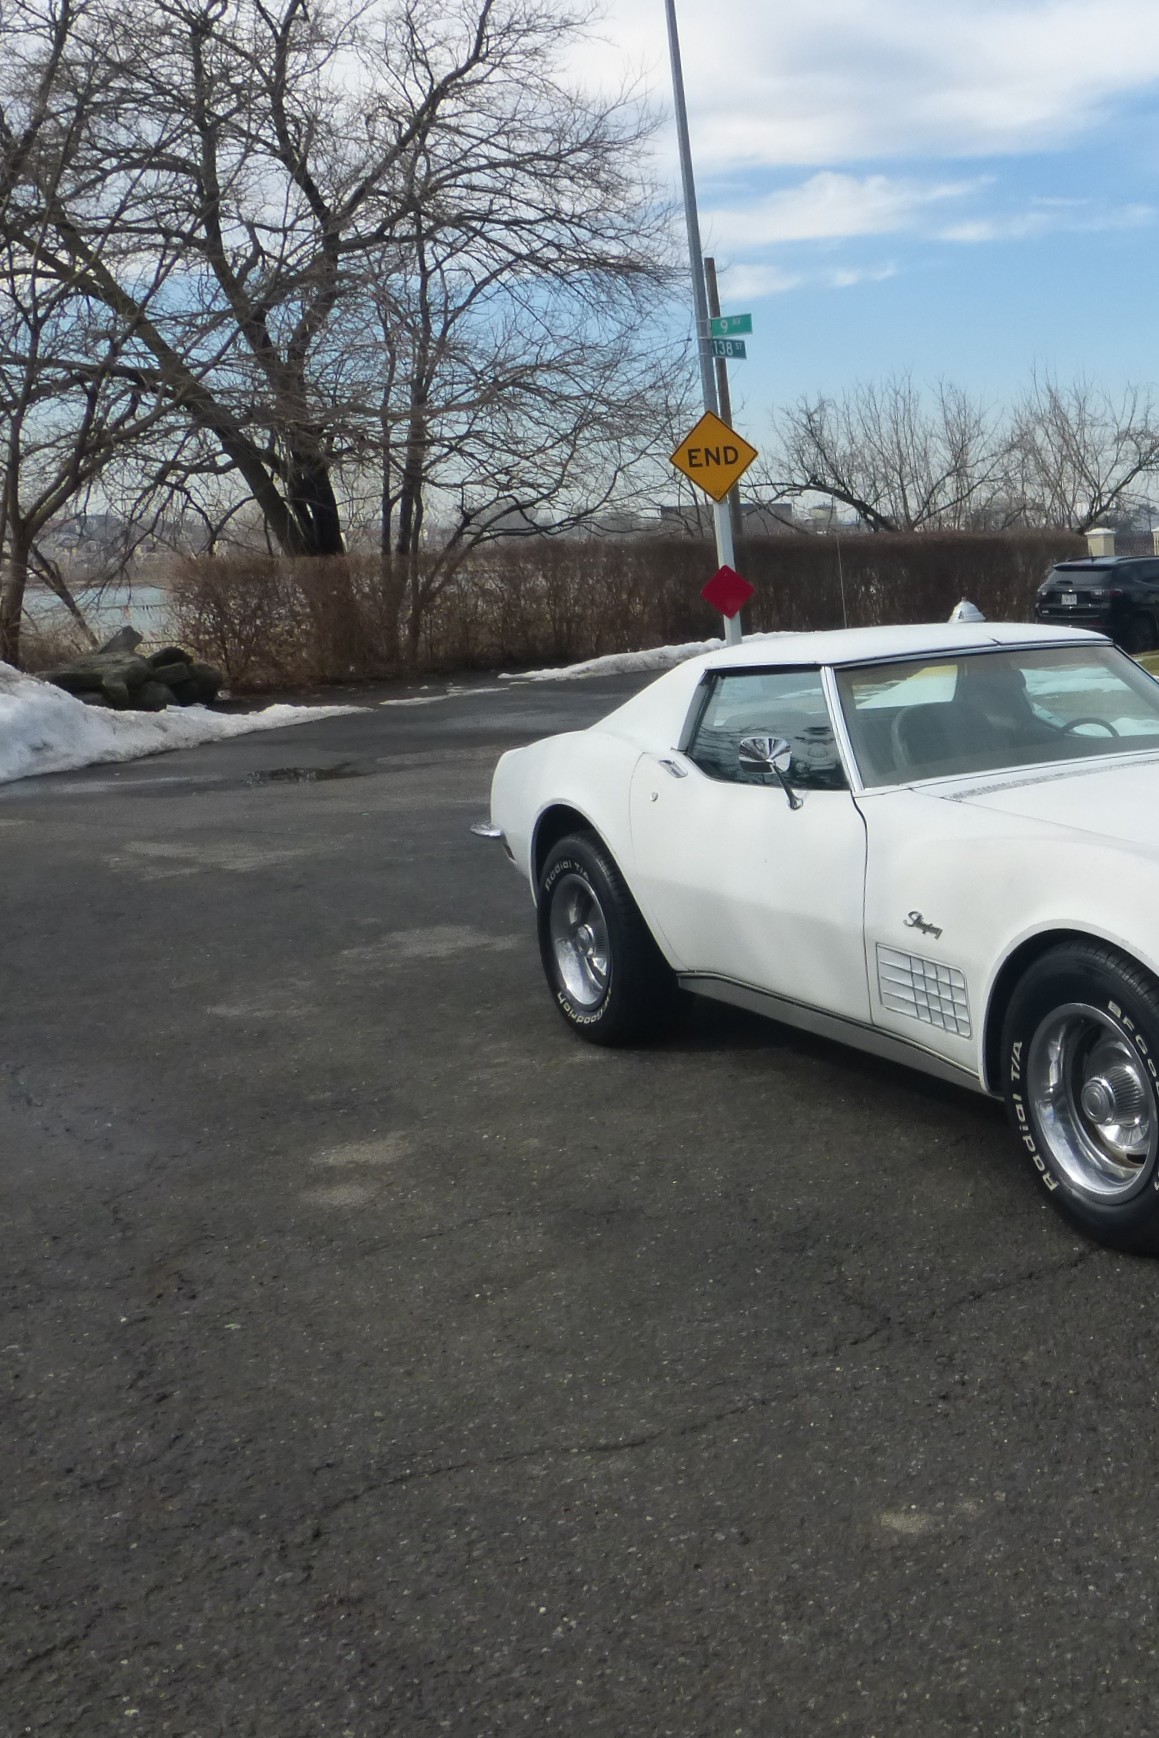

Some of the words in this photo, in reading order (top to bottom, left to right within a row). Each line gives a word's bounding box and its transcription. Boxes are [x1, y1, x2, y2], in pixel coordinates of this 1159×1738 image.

[720, 319, 728, 334] 9
[713, 340, 734, 356] 138
[735, 342, 743, 351] ST
[688, 446, 739, 468] END
[1010, 1041, 1023, 1082] T/A
[1013, 1093, 1060, 1192] Radial
